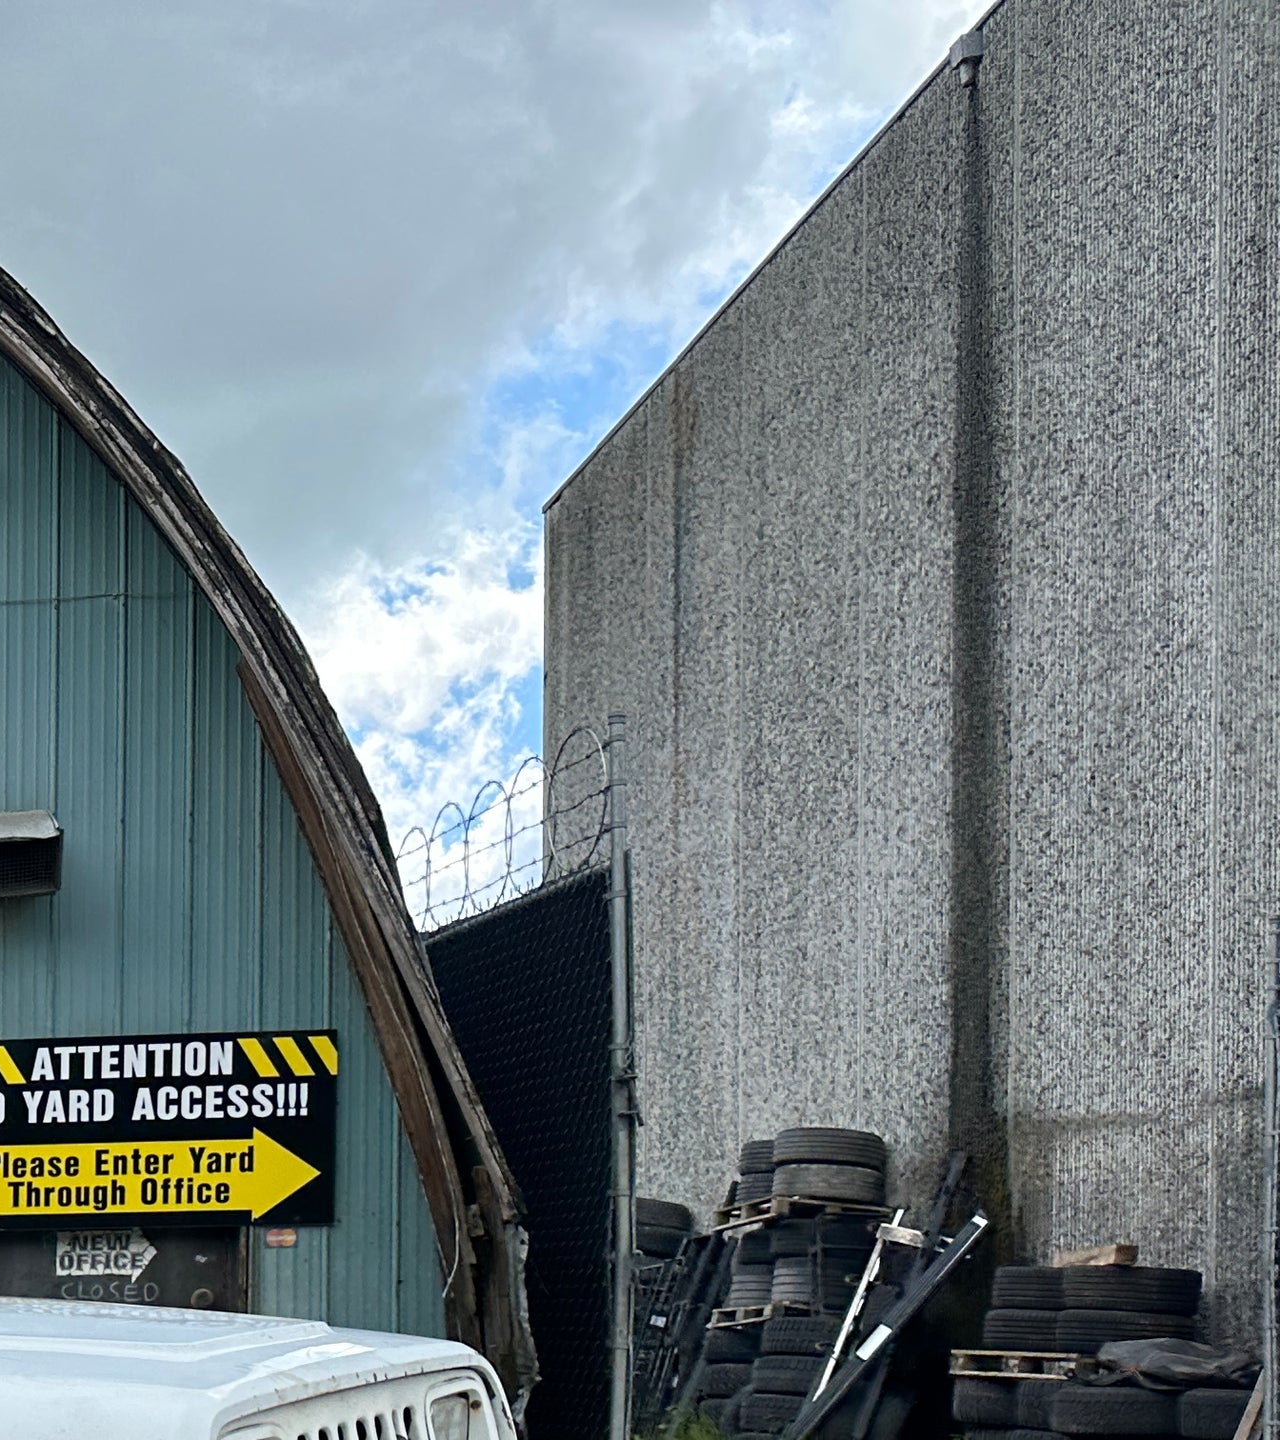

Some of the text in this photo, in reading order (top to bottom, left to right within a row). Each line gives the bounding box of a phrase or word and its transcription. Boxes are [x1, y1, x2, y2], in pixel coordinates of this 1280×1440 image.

[30, 1041, 234, 1081] ATTENTION
[22, 1089, 114, 1125] YARD
[131, 1083, 310, 1122] ACCESS!!!
[95, 1149, 175, 1177] Enter
[189, 1146, 255, 1174] Yard
[8, 1177, 231, 1211] Through Office
[71, 1232, 132, 1251] NEW
[59, 1251, 145, 1272] OFFICE
[61, 1281, 160, 1302] CLOSED
